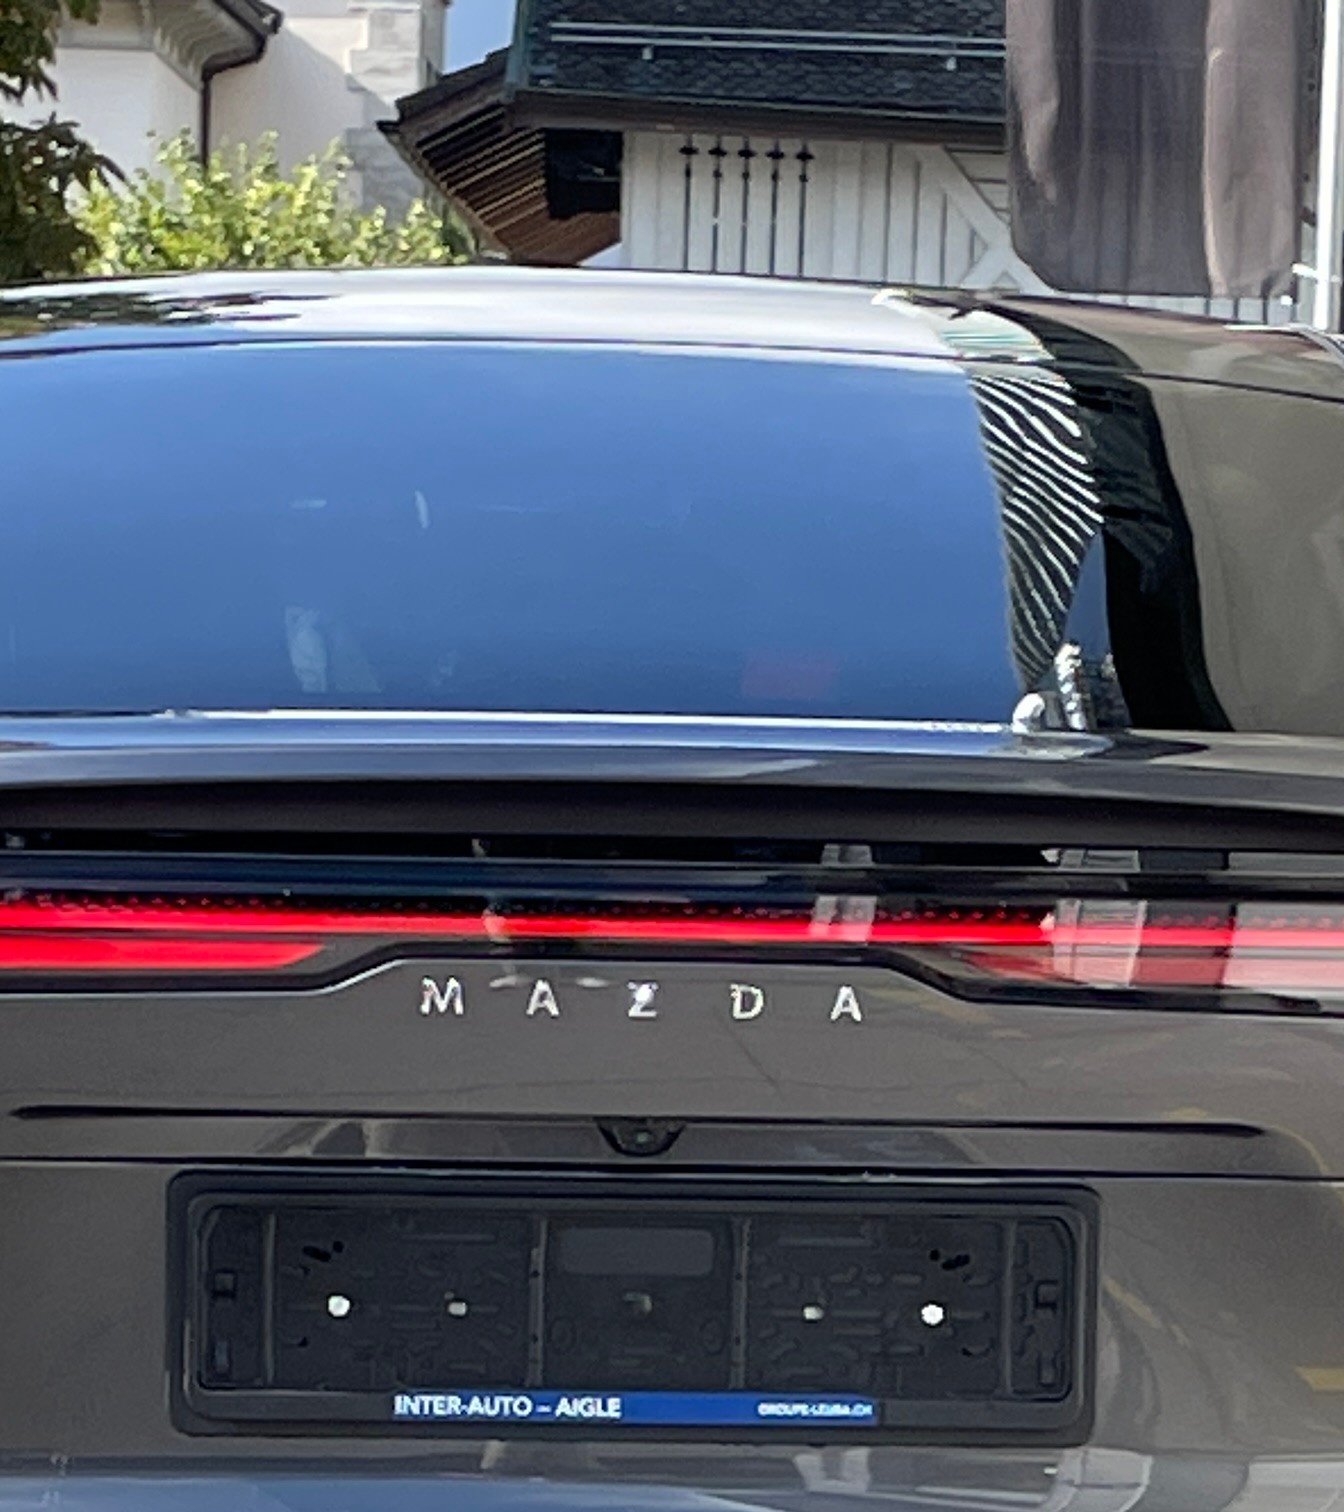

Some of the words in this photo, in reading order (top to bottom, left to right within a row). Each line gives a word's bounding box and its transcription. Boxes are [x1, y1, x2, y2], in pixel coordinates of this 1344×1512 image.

[419, 977, 863, 1022] MAZDA
[393, 1395, 534, 1417] INTER-AUTO
[555, 1397, 623, 1419] AIGLE
